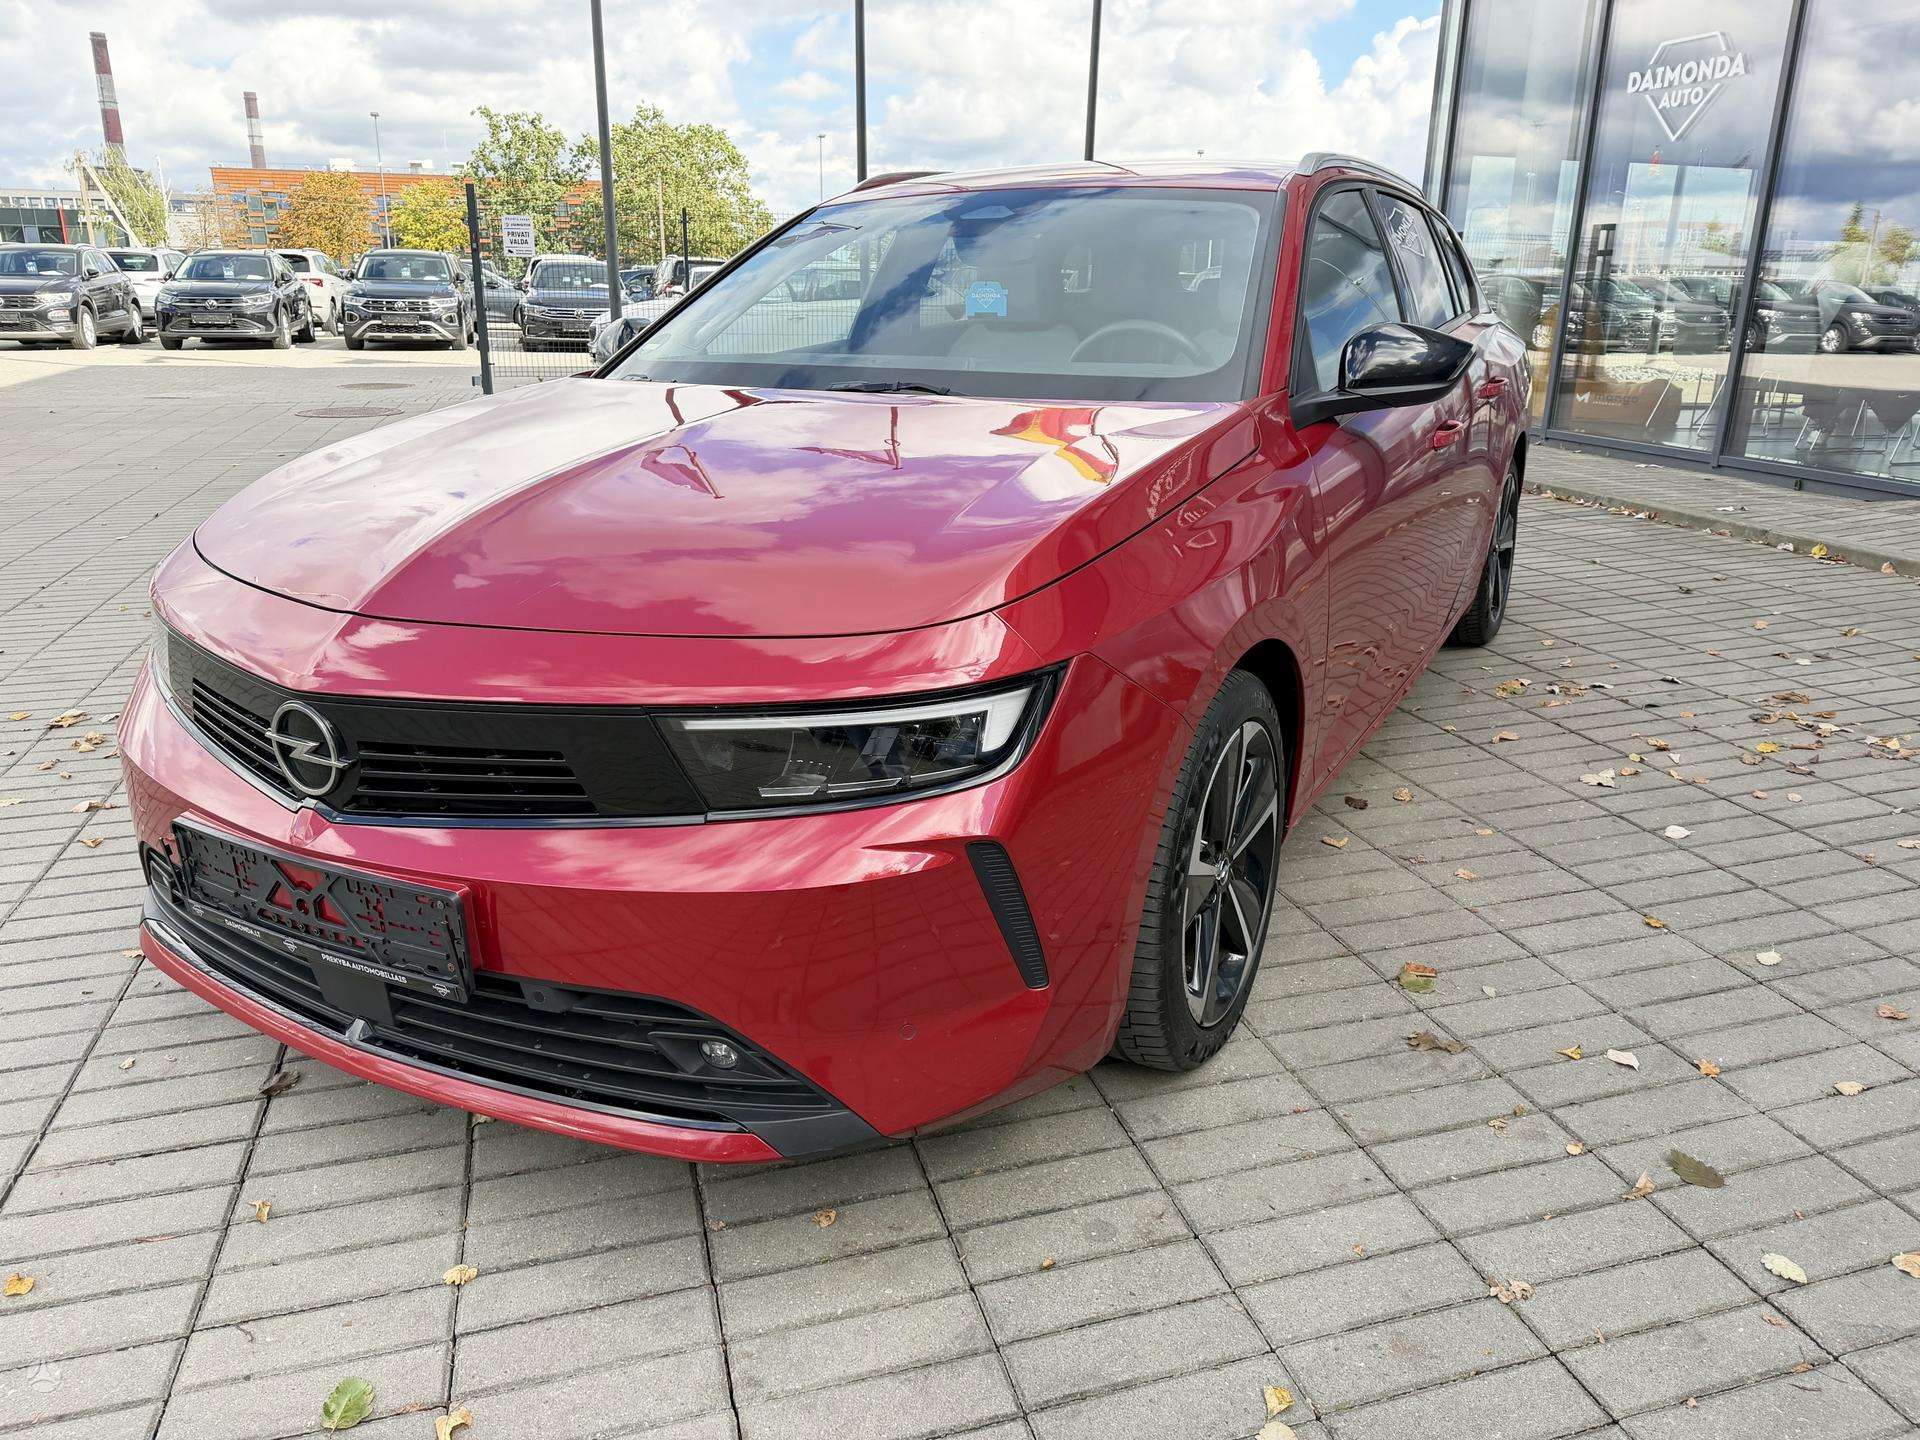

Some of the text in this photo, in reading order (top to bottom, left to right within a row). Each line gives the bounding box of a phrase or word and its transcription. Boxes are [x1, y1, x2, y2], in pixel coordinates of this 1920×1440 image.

[1626, 52, 1746, 94] DAIMONDA
[1658, 86, 1704, 110] AUTO
[321, 953, 408, 984] PREKYBA AUTOMOBILIAIS
